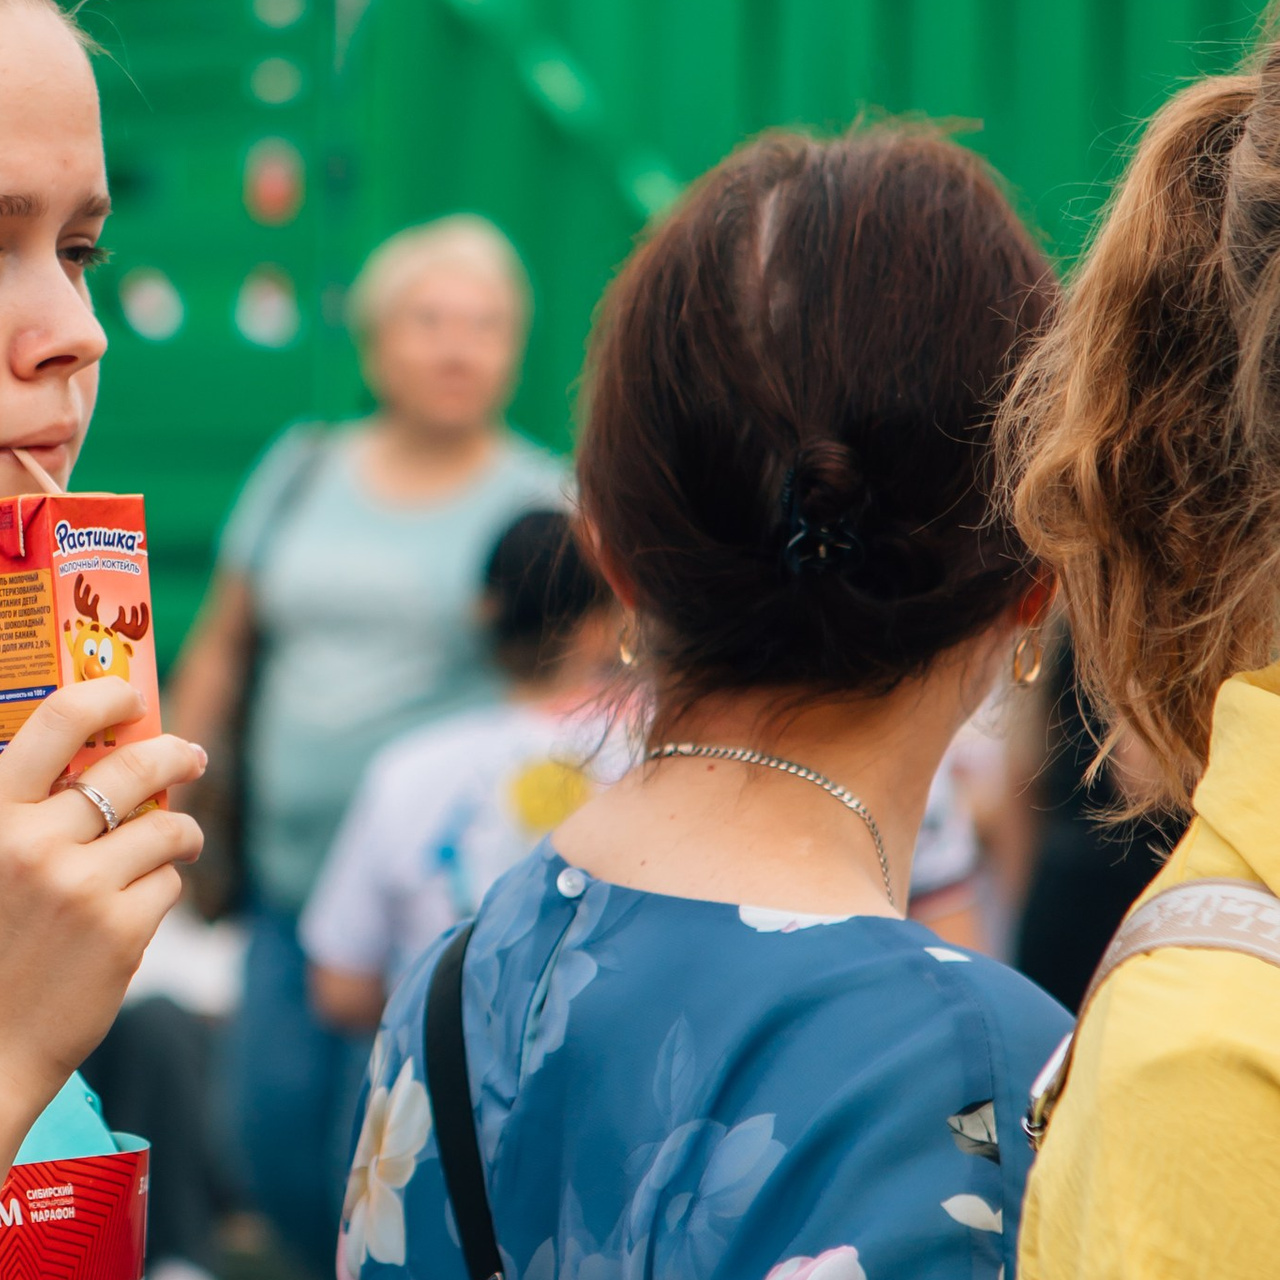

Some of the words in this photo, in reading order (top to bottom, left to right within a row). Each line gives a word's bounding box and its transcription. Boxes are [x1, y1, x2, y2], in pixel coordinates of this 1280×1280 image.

[56, 523, 137, 553] Растишка
[59, 558, 100, 575] МОЛОЧНЫЙ
[101, 559, 140, 574] КОКТЕЙЛЬ
[26, 1183, 74, 1200] СИБИРСКИЙ
[30, 1206, 75, 1223] МАРАФОН
